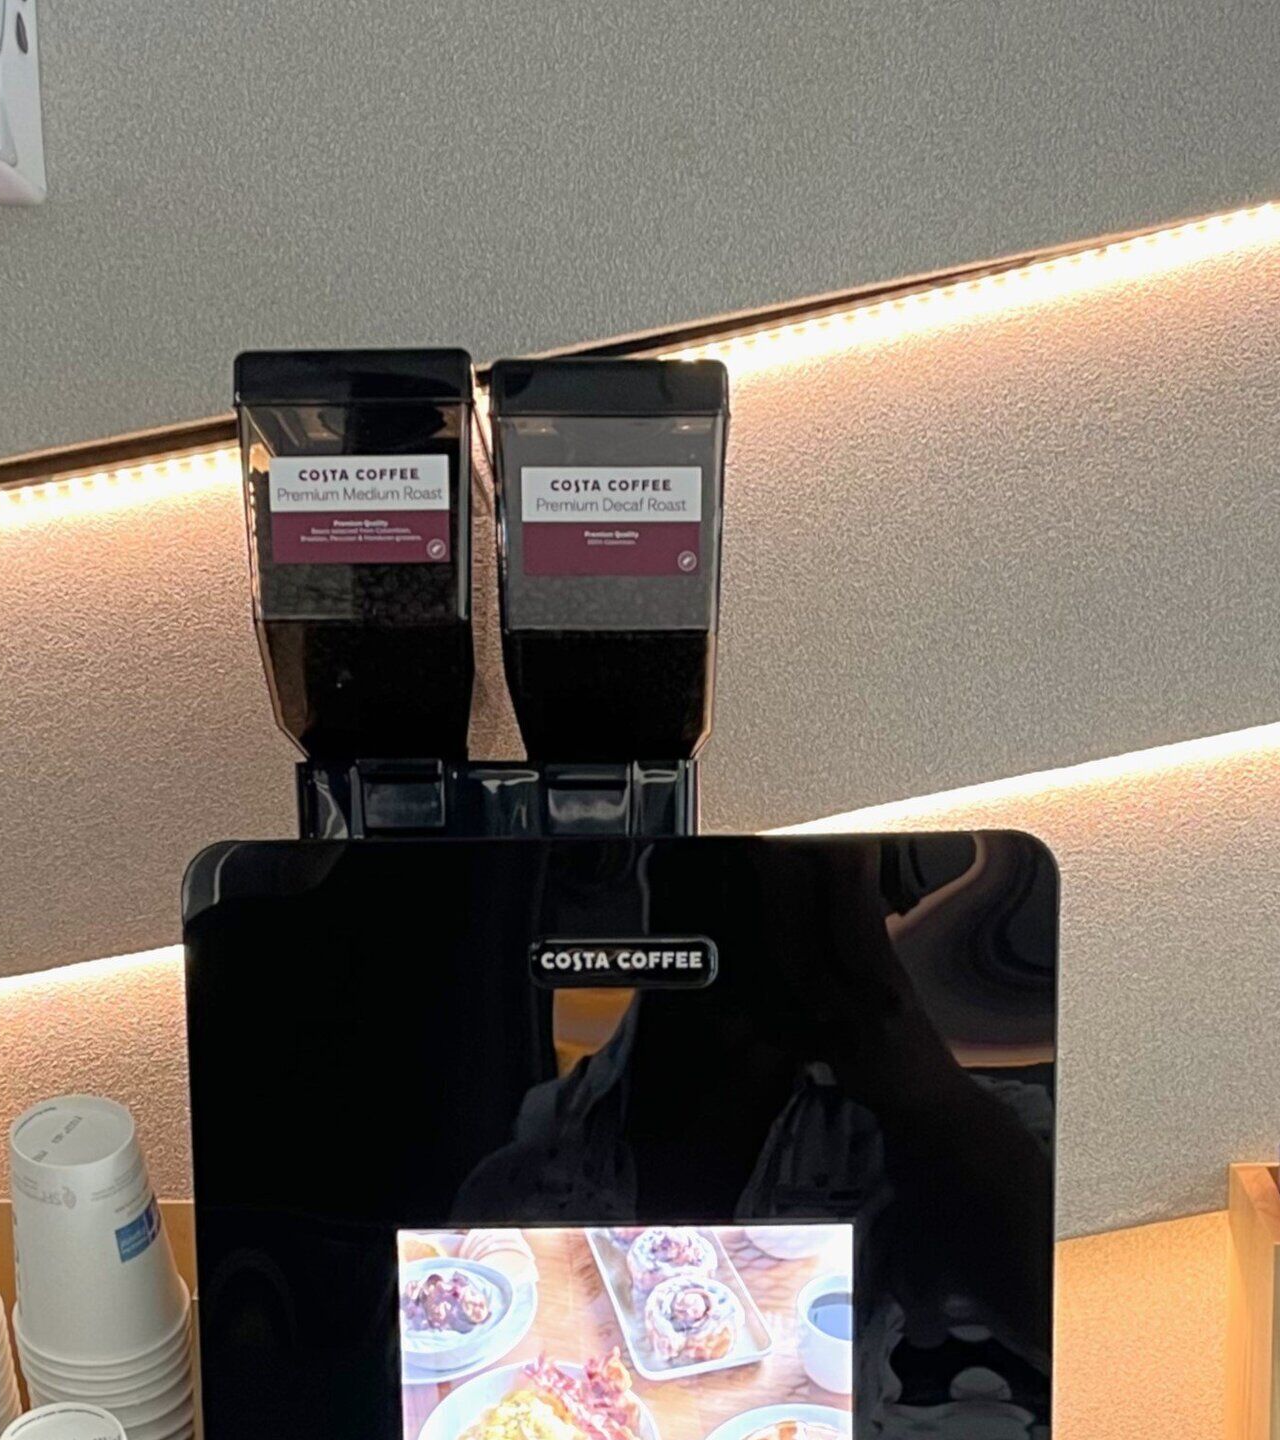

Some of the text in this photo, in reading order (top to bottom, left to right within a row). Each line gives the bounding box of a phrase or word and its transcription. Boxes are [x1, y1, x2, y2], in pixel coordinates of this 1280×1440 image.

[298, 468, 420, 482] COSTA COFFEE
[277, 486, 442, 501] Premium Medium Roast
[550, 480, 671, 492] COSTA COFFEE
[536, 497, 686, 512] Premium Decaf Roast
[541, 952, 702, 972] COSTA COFFEE
